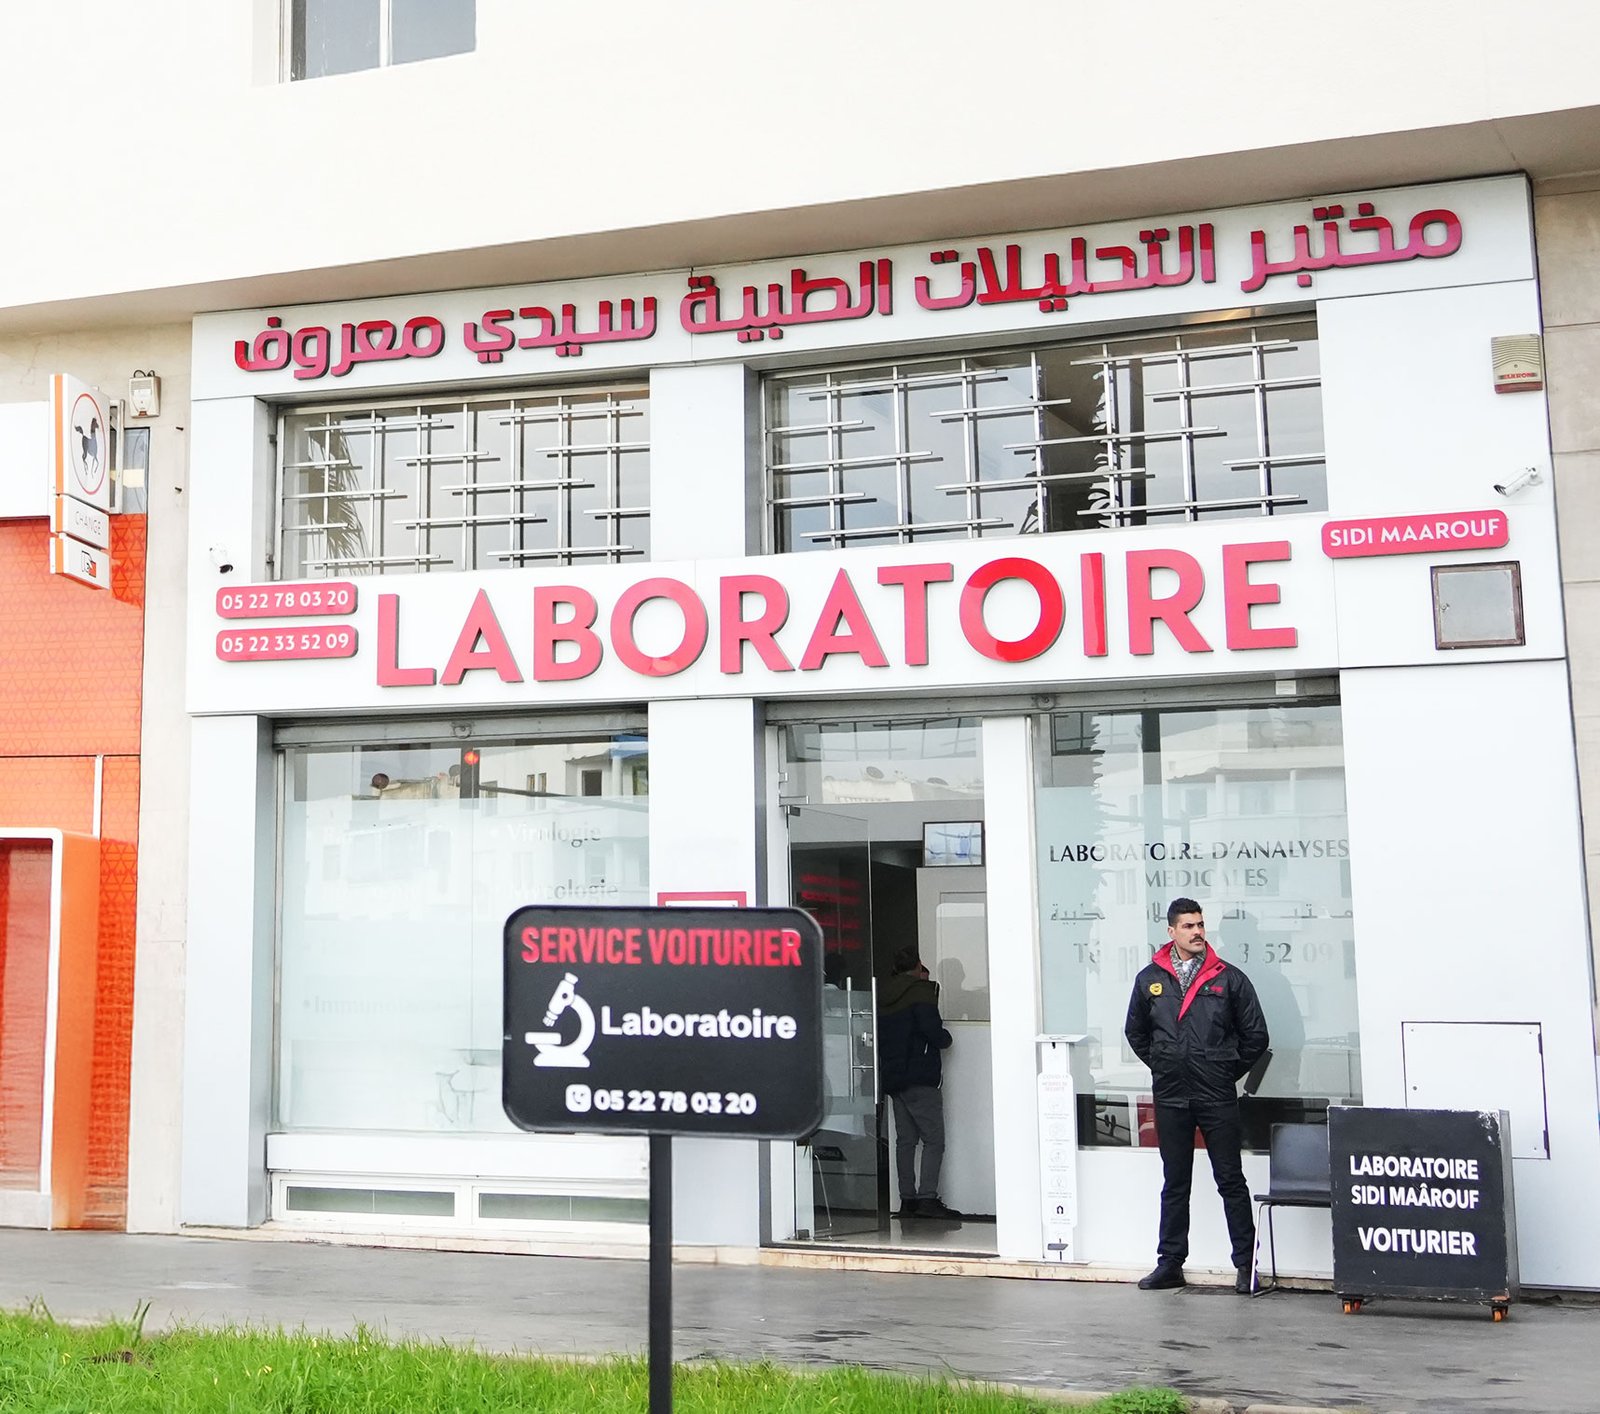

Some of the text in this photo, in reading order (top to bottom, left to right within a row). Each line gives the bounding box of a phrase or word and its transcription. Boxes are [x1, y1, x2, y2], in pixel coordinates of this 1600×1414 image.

[235, 202, 1463, 380] مختبر التحليلات الطبية سيدي معروف
[1330, 518, 1500, 547] SIDI MAAROUF
[222, 590, 349, 610] 05 22 78 03 20
[375, 539, 1299, 688] LABORATOIRE
[222, 633, 349, 653] 05 22 33 52 09
[521, 926, 803, 967] SERVICE VOITURIER
[601, 1005, 797, 1039] Laboratoire
[594, 1089, 757, 1115] 05 22 78 03 20
[1350, 1155, 1479, 1180] LABORATOIRE
[1351, 1182, 1480, 1209] SIDI MAÂROUF
[1357, 1226, 1477, 1256] VOITURIER
